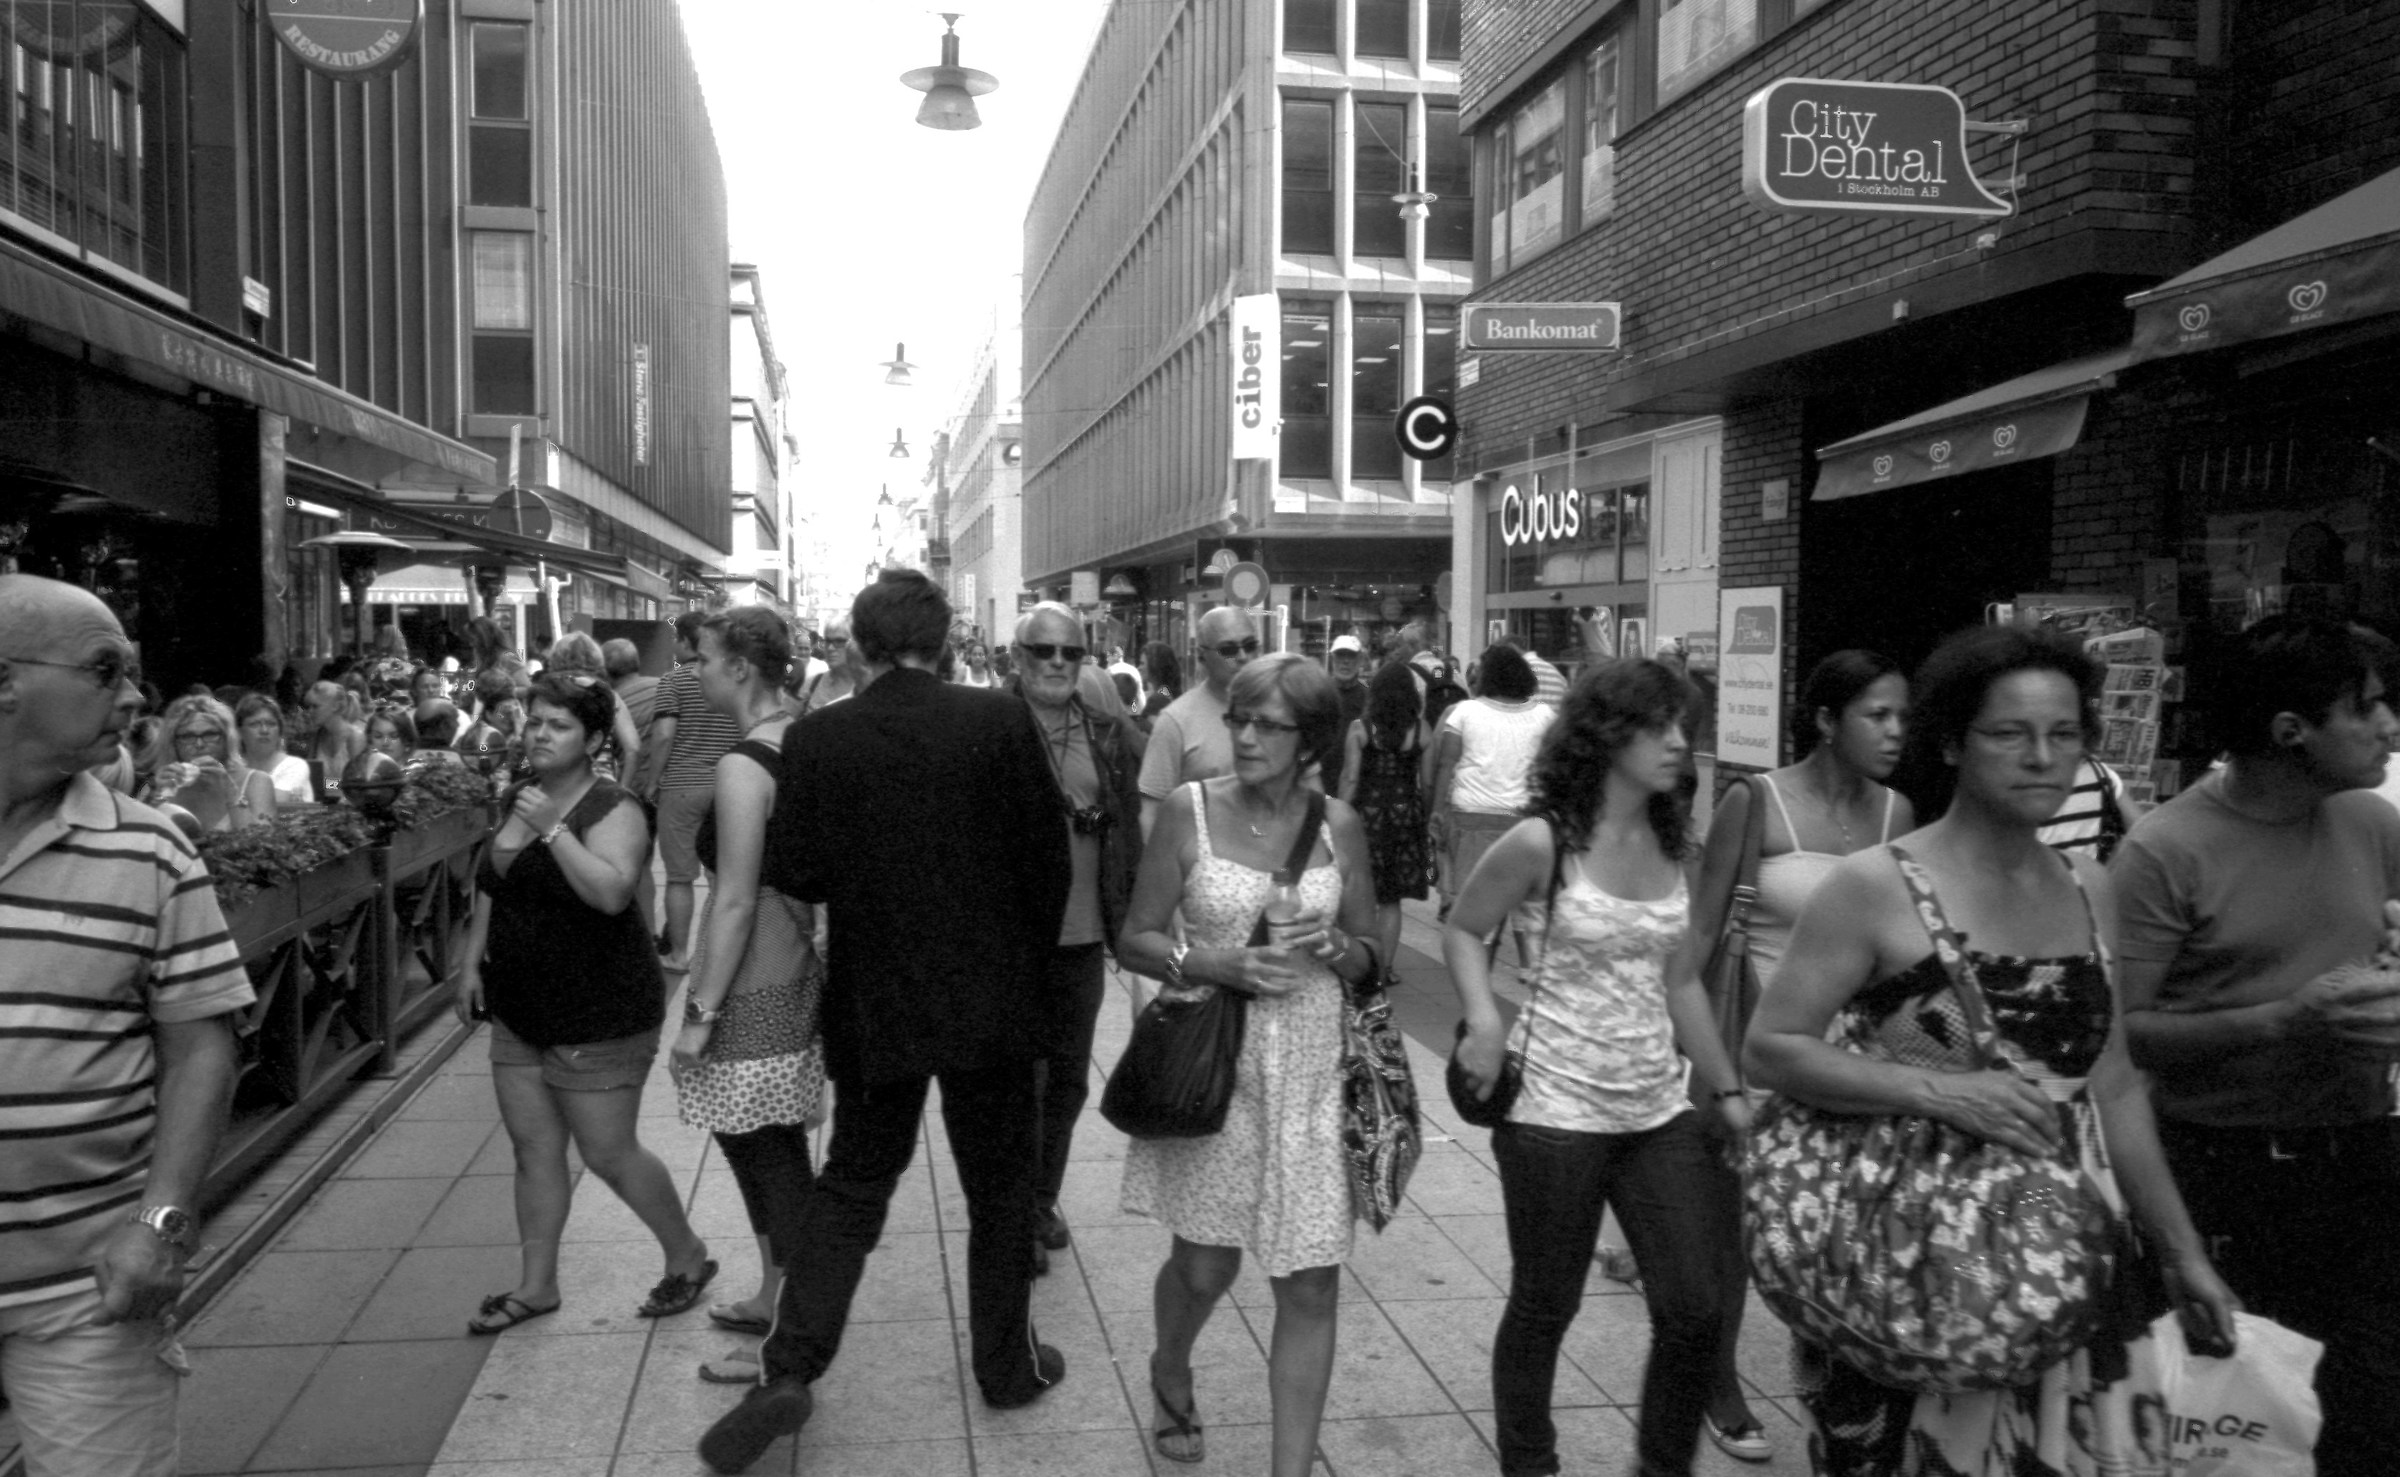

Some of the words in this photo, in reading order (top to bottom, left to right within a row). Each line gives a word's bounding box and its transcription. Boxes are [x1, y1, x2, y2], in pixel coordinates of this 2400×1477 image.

[284, 24, 400, 67] RESTAURANG
[1790, 99, 1877, 149] City
[1780, 133, 1947, 184] Dental
[1847, 183, 1916, 197] Stockholm
[1920, 187, 1940, 198] AB
[1235, 325, 1262, 430] ciber
[1501, 472, 1580, 546] Cubus
